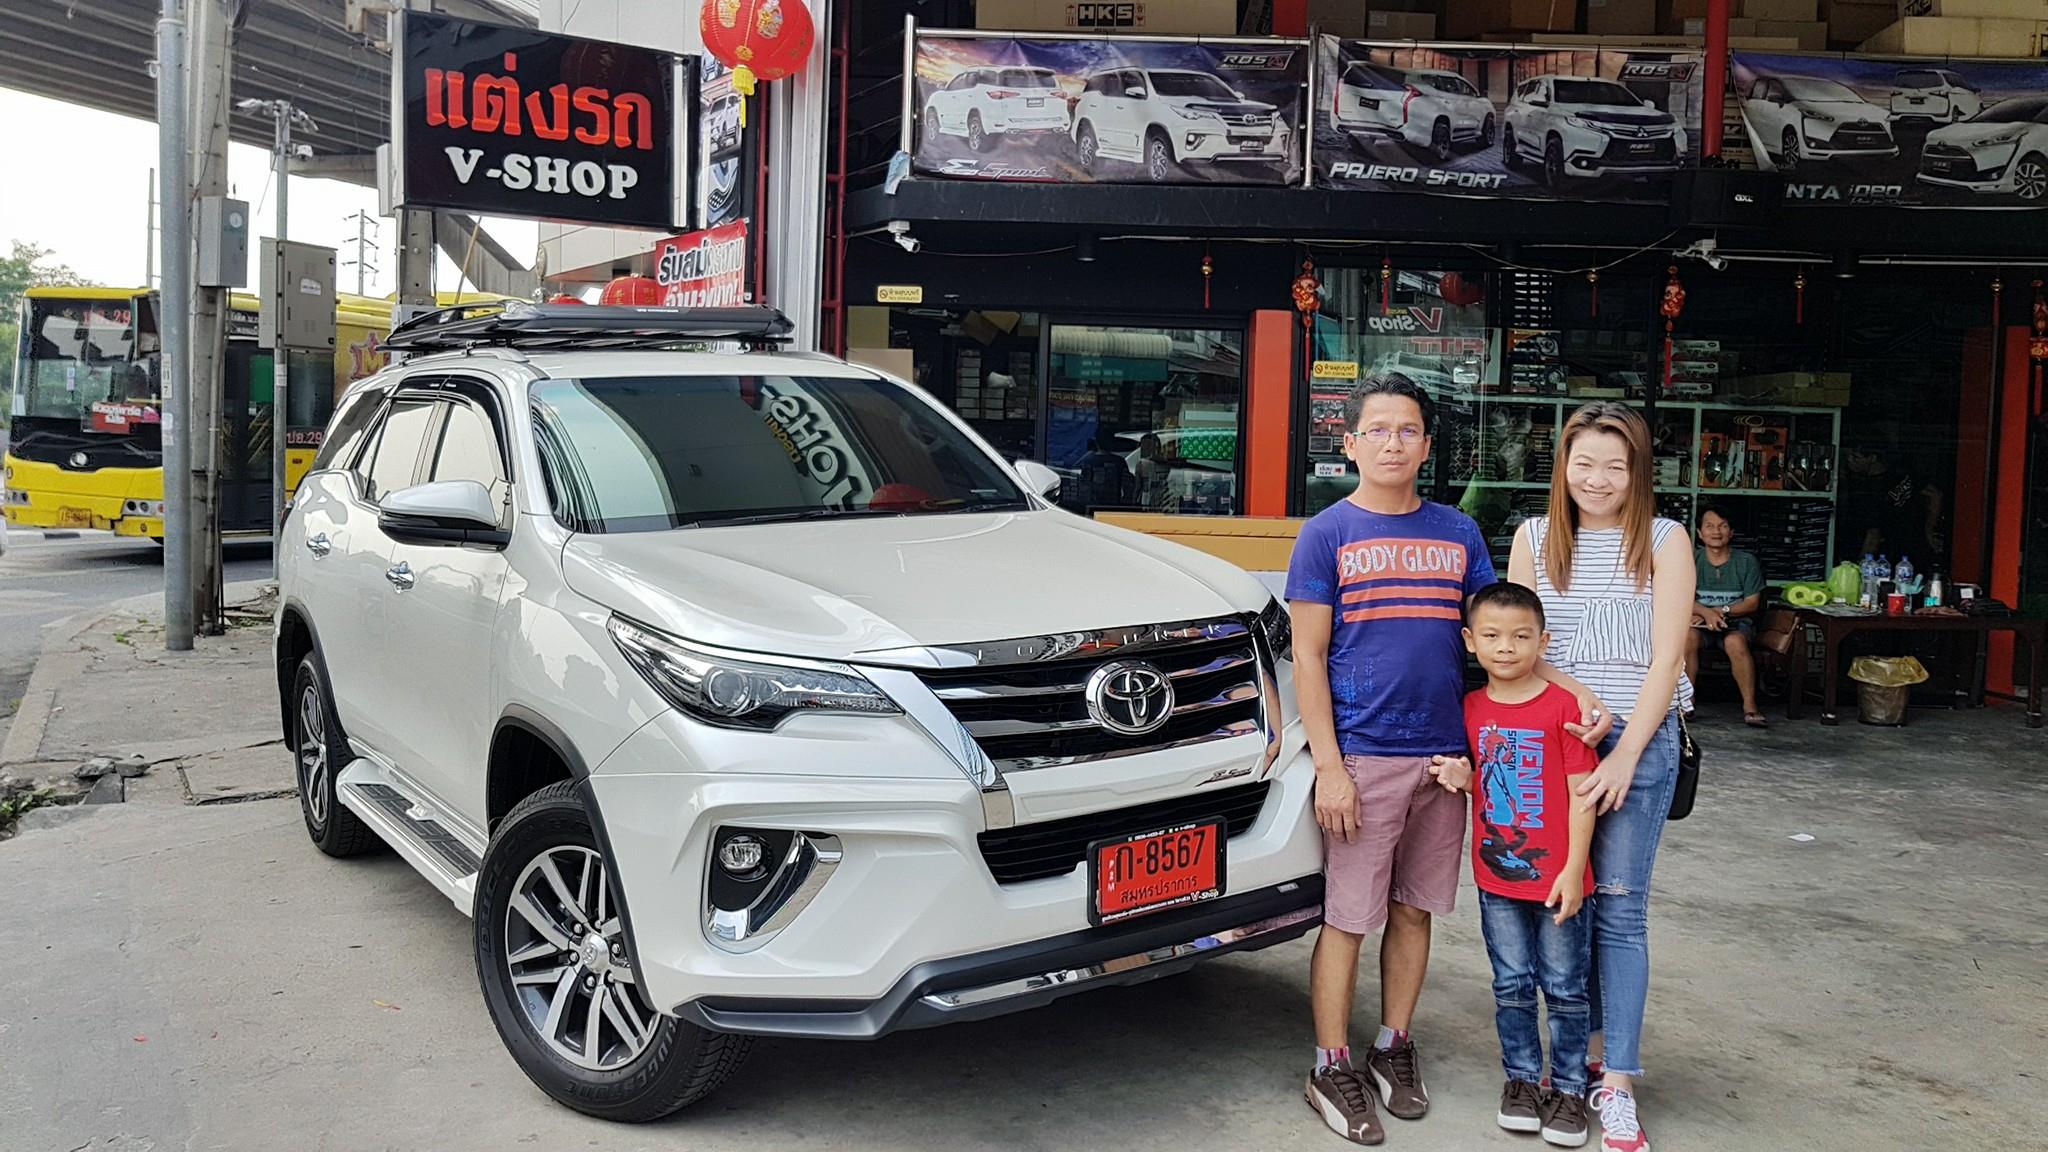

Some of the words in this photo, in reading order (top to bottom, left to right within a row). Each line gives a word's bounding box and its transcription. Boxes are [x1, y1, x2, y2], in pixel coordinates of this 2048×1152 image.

[1078, 4, 1134, 22] HKS
[425, 52, 653, 150] แต่งรถ
[444, 146, 638, 199] V-SHOP
[1328, 162, 1418, 182] PAJERO
[1426, 169, 1507, 189] SPORT
[1785, 183, 1840, 199] NTA
[1341, 545, 1398, 577] BODY
[1401, 545, 1461, 575] GLOVE
[1517, 728, 1545, 829] VENOM
[1115, 829, 1207, 883] ก-8567
[1120, 875, 1198, 906] สมุทรปราการ
